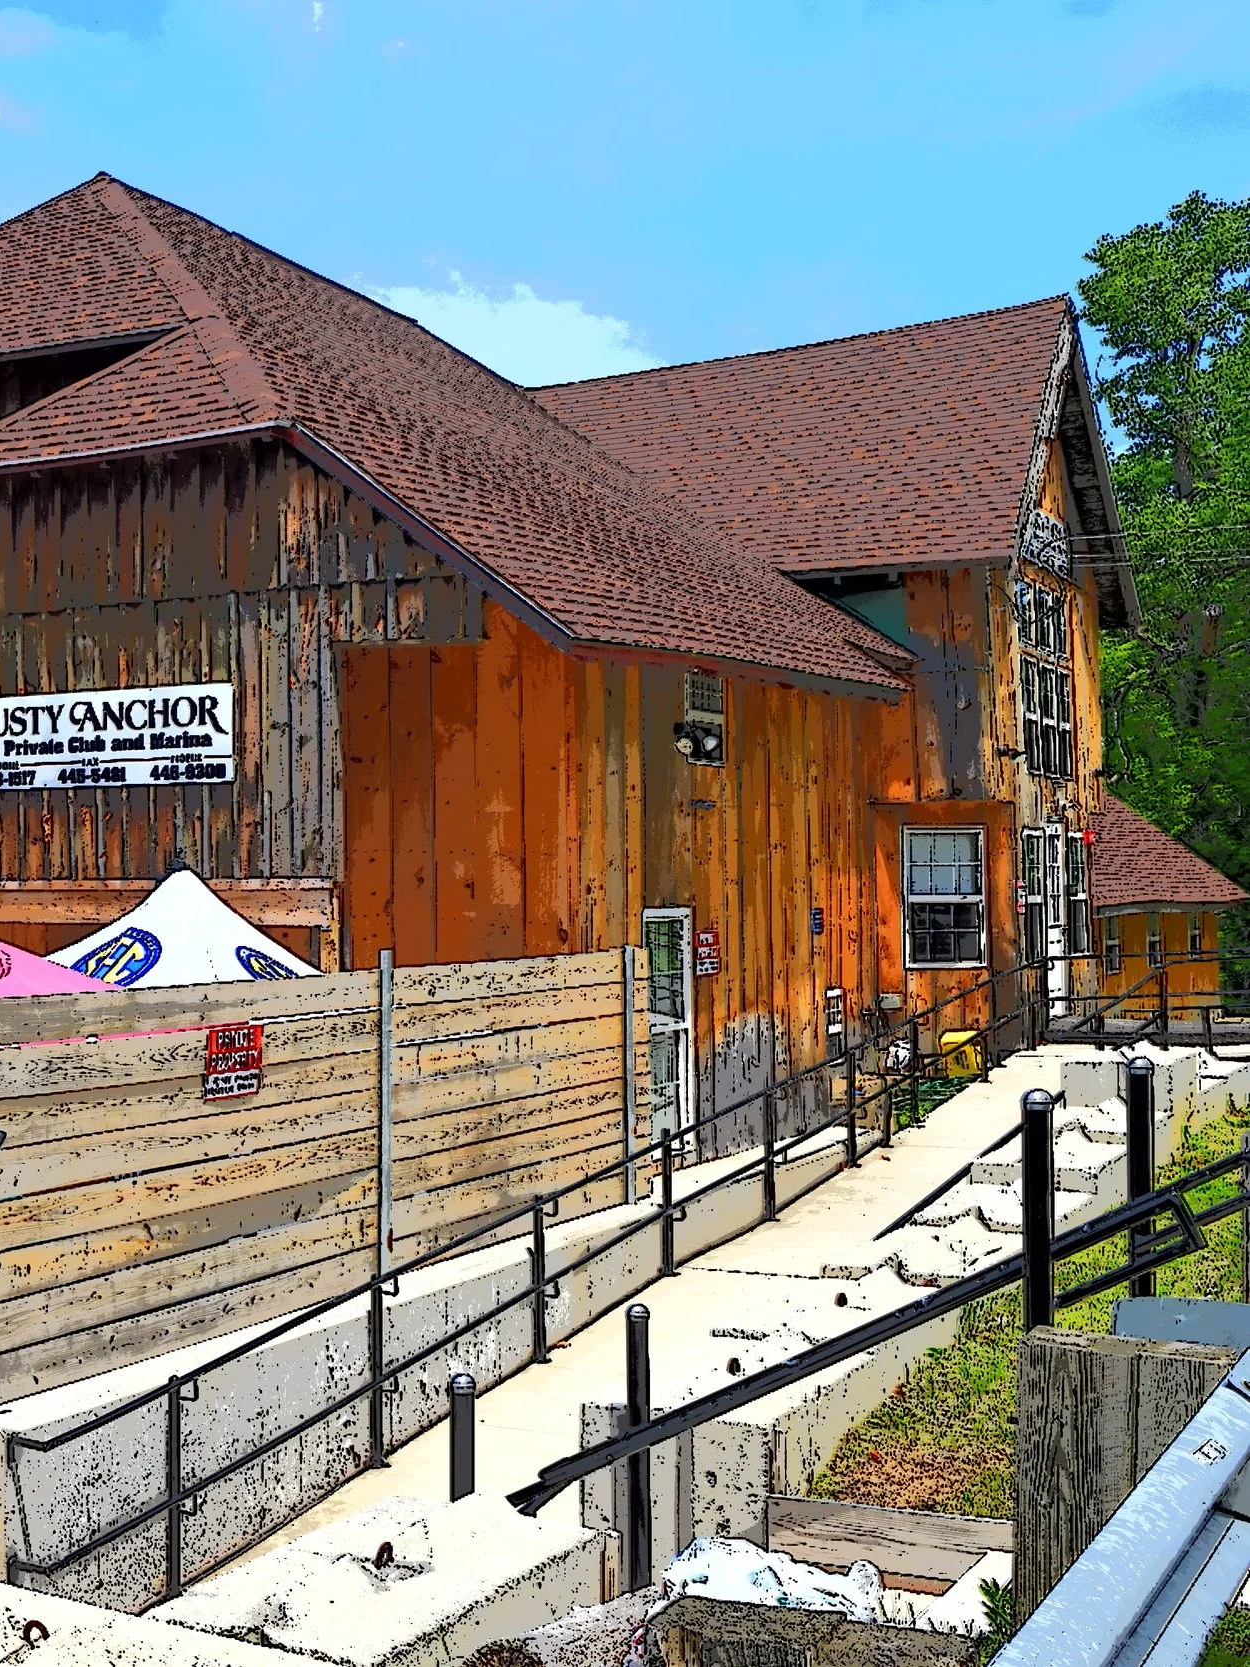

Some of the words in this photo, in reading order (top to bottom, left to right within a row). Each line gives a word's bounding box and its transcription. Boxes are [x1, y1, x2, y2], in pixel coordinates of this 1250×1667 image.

[69, 695, 229, 735] ANCHOR
[3, 739, 64, 756] Private
[67, 735, 105, 754] Club
[110, 733, 145, 751] and
[149, 730, 213, 750] Marina
